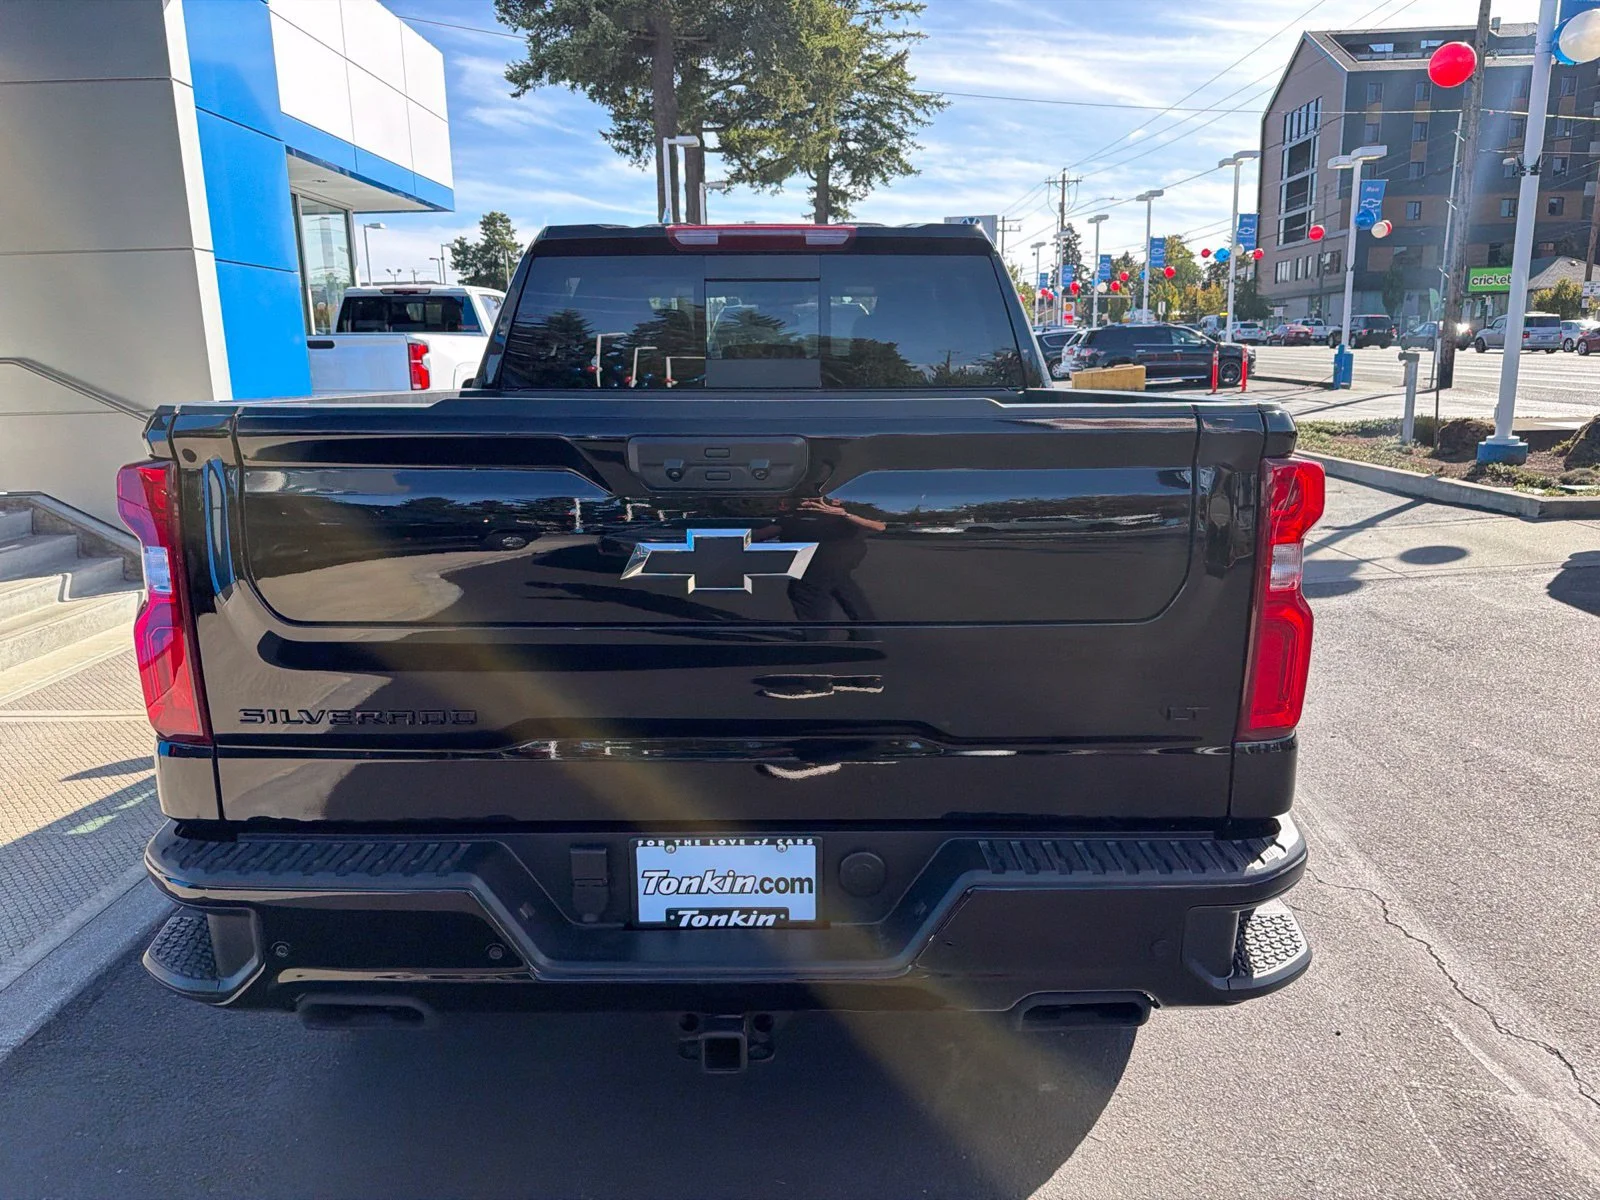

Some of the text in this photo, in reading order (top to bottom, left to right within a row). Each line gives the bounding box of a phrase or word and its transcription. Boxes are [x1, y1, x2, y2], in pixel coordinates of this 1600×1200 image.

[1471, 274, 1512, 286] cricket
[239, 708, 477, 726] SILVERADO
[776, 838, 814, 846] CARS
[641, 869, 814, 896] Tonkin.com
[677, 910, 777, 928] Tonkin
